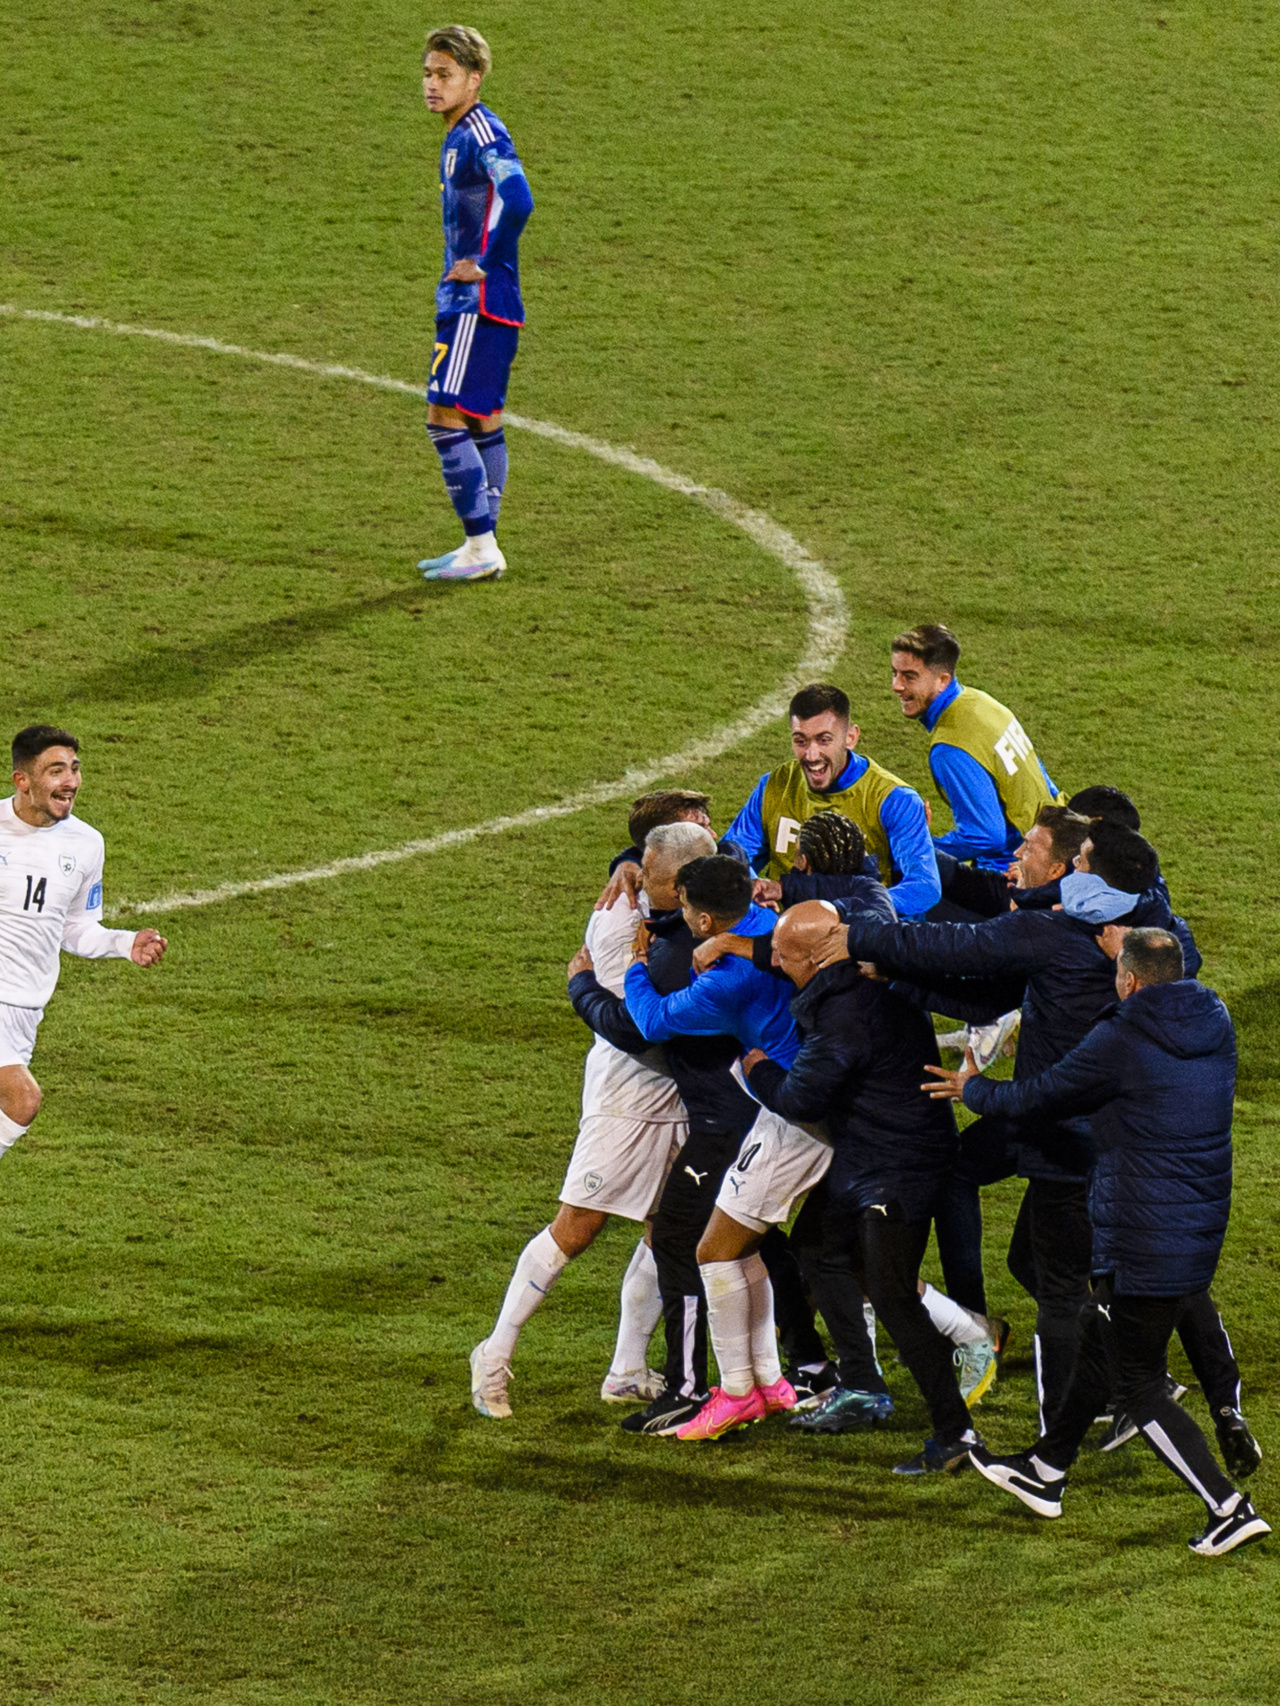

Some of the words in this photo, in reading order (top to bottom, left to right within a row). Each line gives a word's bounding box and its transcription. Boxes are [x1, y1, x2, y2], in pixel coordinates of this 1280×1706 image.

[431, 342, 448, 376] 7
[993, 717, 1033, 776] FIF
[23, 875, 47, 913] 14
